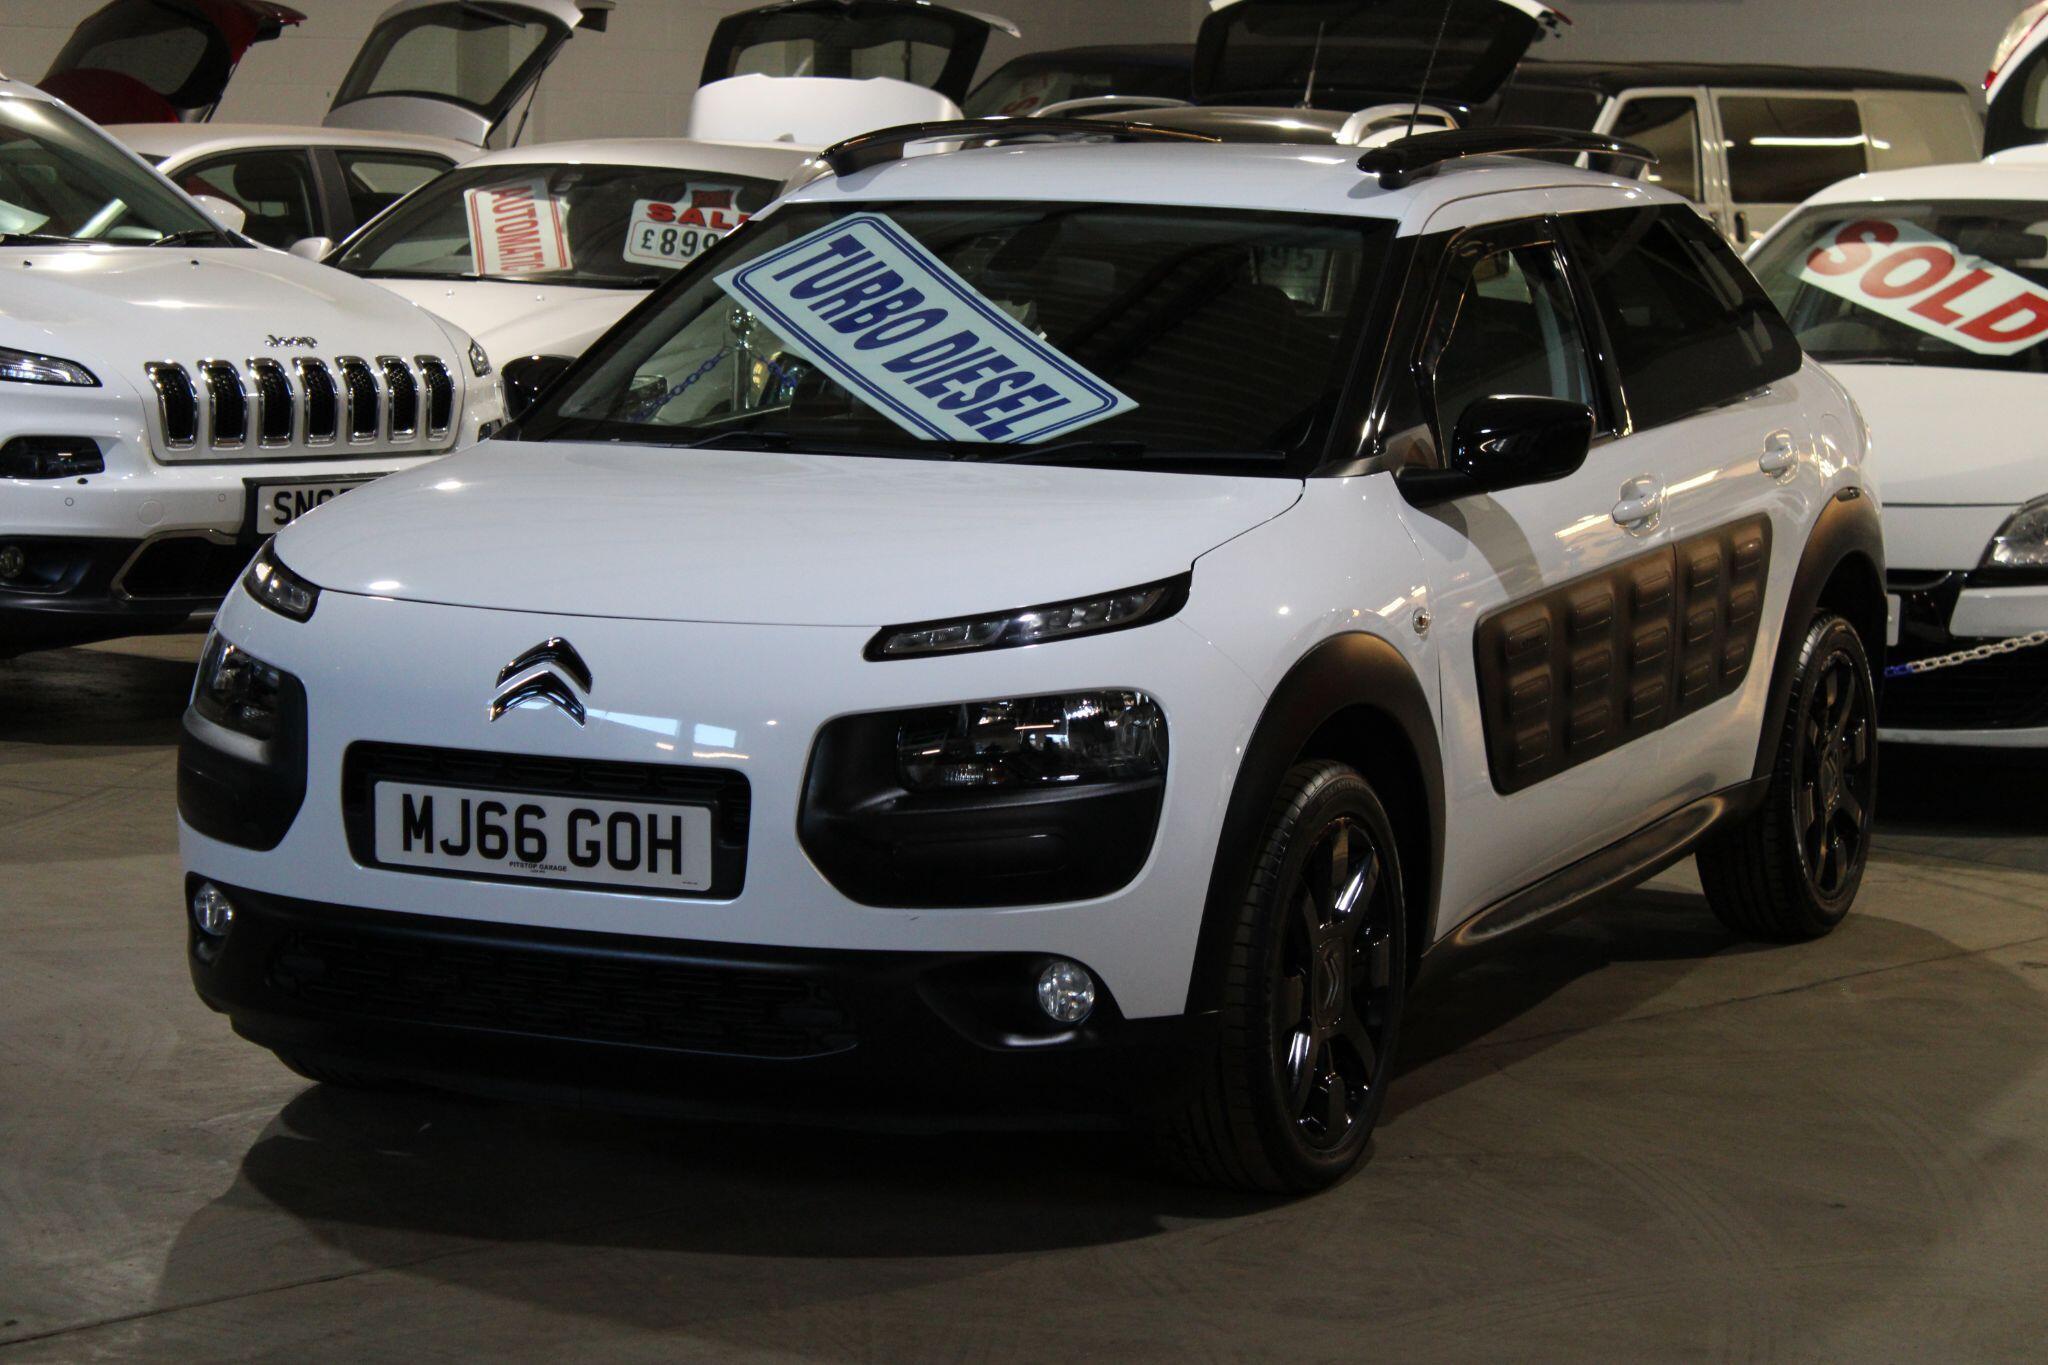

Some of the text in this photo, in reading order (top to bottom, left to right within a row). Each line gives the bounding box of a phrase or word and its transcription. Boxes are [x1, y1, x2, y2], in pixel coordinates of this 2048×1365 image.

[490, 185, 545, 271] AUTOMATIC
[1806, 220, 2048, 343] SOLD
[772, 234, 1072, 440] TURBO DIESEL
[273, 488, 354, 525] SN
[402, 793, 682, 875] MJ66 GOH
[509, 861, 538, 870] PITSTOP
[539, 864, 568, 872] GARAGE
